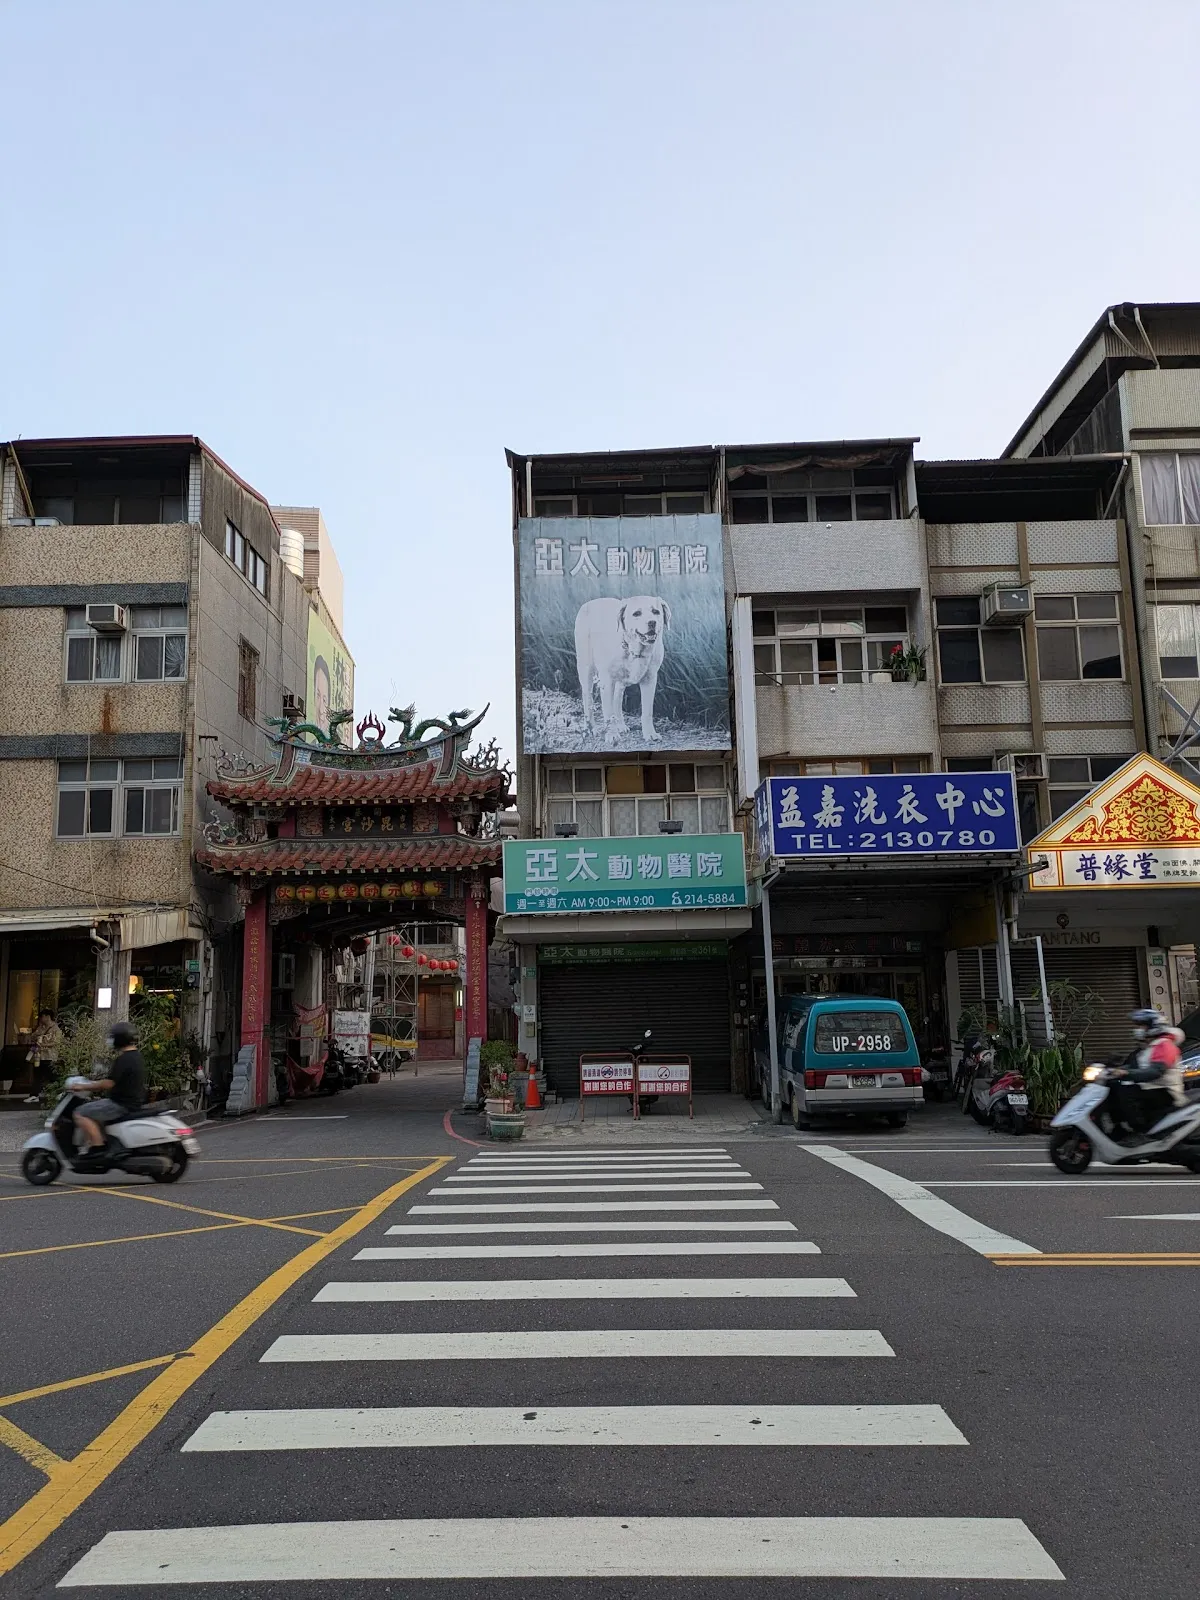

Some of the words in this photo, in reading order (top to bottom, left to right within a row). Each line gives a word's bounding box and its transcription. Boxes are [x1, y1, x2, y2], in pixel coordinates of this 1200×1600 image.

[534, 538, 709, 577] 亞太動物醫院
[777, 781, 1006, 829] 益嘉洗衣中心
[791, 829, 996, 850] TEL:2130780
[526, 847, 723, 882] 亞太動物醫院
[1075, 852, 1159, 881] 普緣堂
[571, 898, 586, 908] AM
[633, 895, 655, 906] 9:00
[684, 892, 736, 905] 214-5884
[543, 946, 625, 958] 亞太動物醫院
[832, 1034, 891, 1053] UP-2958
[584, 1081, 632, 1091] 謝謝您的合作
[641, 1082, 688, 1092] 謝謝您的合作
